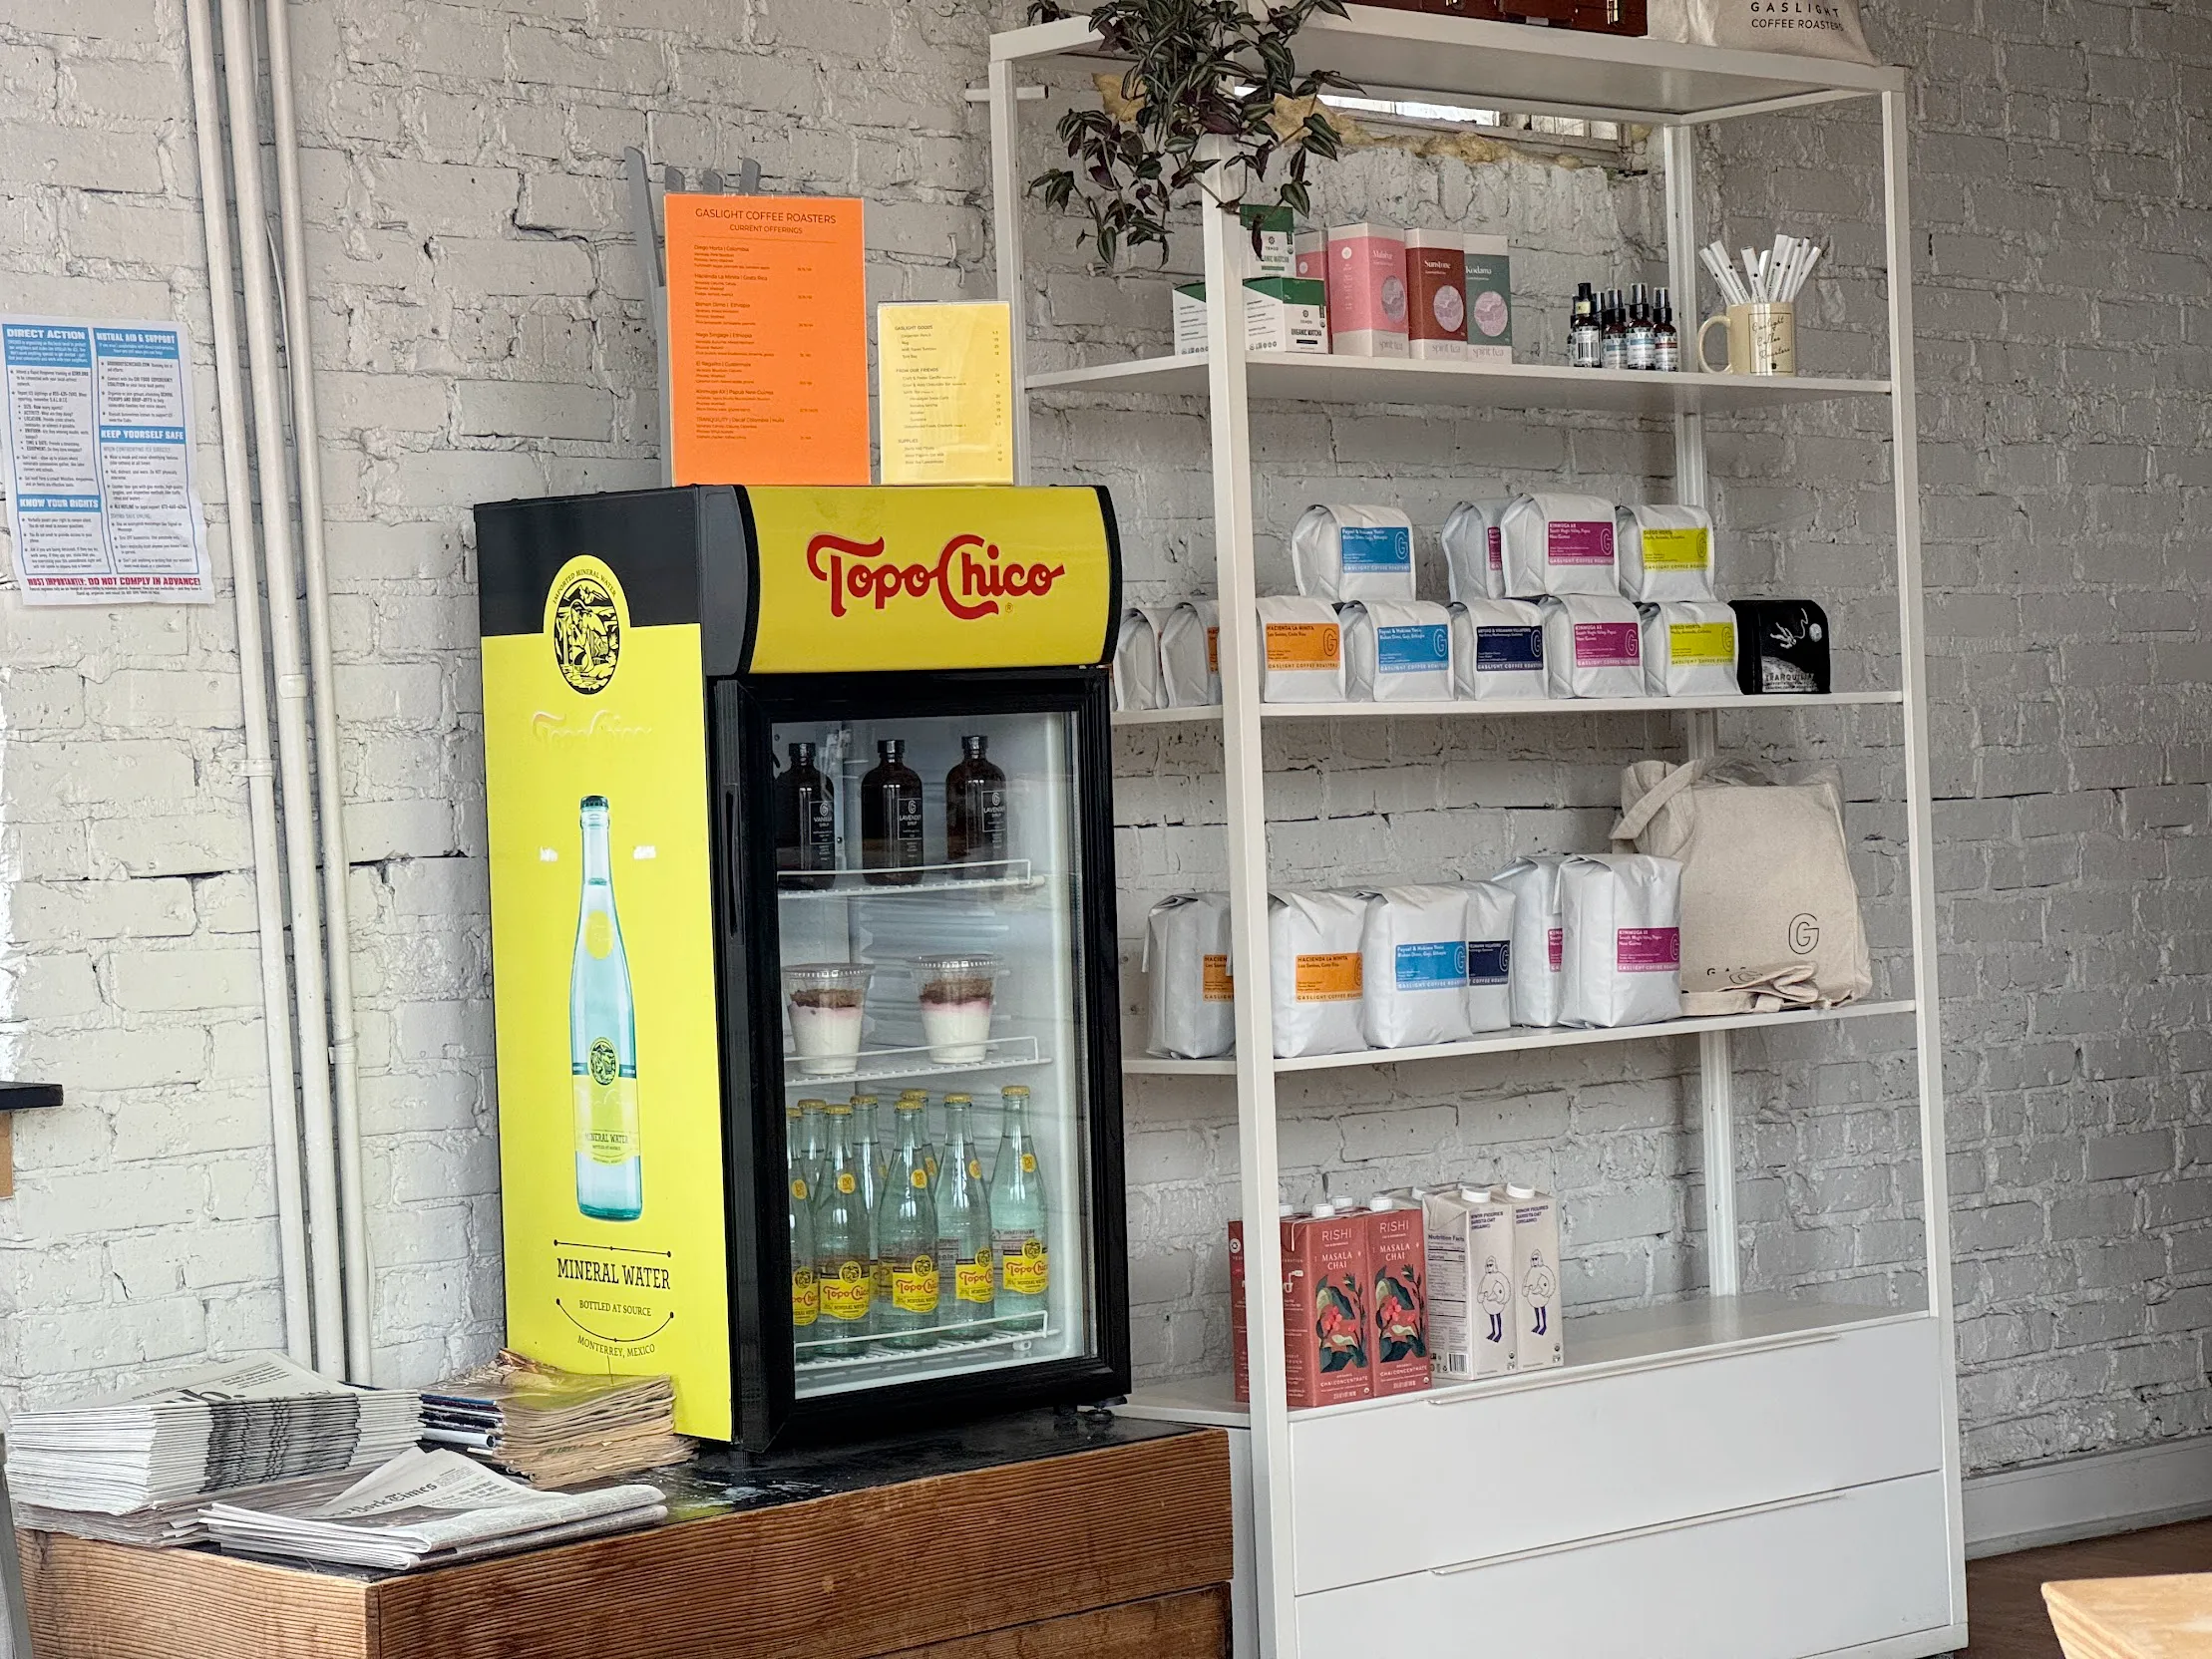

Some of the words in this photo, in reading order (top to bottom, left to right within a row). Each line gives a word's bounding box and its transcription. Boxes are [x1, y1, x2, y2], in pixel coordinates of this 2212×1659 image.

[1751, 2, 1838, 18] GASLIGHT
[1751, 19, 1794, 28] COFFEE
[1798, 20, 1844, 31] ROASTERS
[695, 208, 744, 219] GASLIGHT
[746, 210, 784, 221] COFFEE
[787, 213, 837, 223] ROASTERS
[764, 225, 803, 234] OFFERINGS
[1465, 265, 1492, 274] Kodama
[7, 329, 44, 338] DIRECT
[47, 330, 86, 339] ACTION
[126, 333, 139, 342] AID
[145, 334, 175, 344] SUPPORT
[1432, 343, 1449, 353] spirit
[1472, 347, 1490, 358] spirit
[101, 430, 120, 439] KEEP
[124, 430, 164, 439] YOURSELF
[166, 431, 184, 440] SAFE
[20, 498, 45, 507] KNOW
[46, 498, 68, 507] YOUR
[1395, 530, 1409, 559] G
[1601, 528, 1612, 555] G
[27, 577, 45, 586] MOST
[88, 577, 100, 586] DO
[101, 577, 118, 586] NOT
[120, 577, 150, 586] COMPLY
[152, 577, 162, 586] IN
[807, 534, 931, 618] Topo
[937, 533, 1065, 620] Chico
[553, 572, 574, 604] IMPORTED
[576, 569, 599, 578] MINERAL
[600, 574, 616, 597] WATER
[1323, 628, 1337, 656] G
[1433, 629, 1446, 657] G
[1531, 630, 1542, 657] G
[1626, 629, 1638, 656] G
[1788, 912, 1820, 955] G
[1454, 945, 1466, 974] G
[1499, 944, 1510, 972] G
[1379, 1219, 1409, 1233] RISHI
[1321, 1228, 1352, 1242] RISHI
[1380, 1242, 1410, 1253] MASALA
[1321, 1252, 1352, 1262] MASALA
[1385, 1251, 1405, 1261] CHAI
[1006, 1262, 1031, 1277] Topo
[1327, 1261, 1347, 1270] CHAI
[556, 1257, 619, 1284] MINERAL
[622, 1264, 671, 1290] WATER
[959, 1271, 983, 1285] Topo
[823, 1286, 850, 1300] Topo
[896, 1279, 922, 1294] Topo
[578, 1299, 611, 1312] BOTTLED
[611, 1302, 622, 1313] AT
[622, 1304, 651, 1317] SOURCE
[576, 1334, 625, 1358] MONTERREY,
[626, 1343, 656, 1357] MEXICO
[1393, 1365, 1427, 1376] CONCENTRATE
[1333, 1376, 1368, 1385] CONCENTRATE
[387, 1482, 437, 1502] Times
